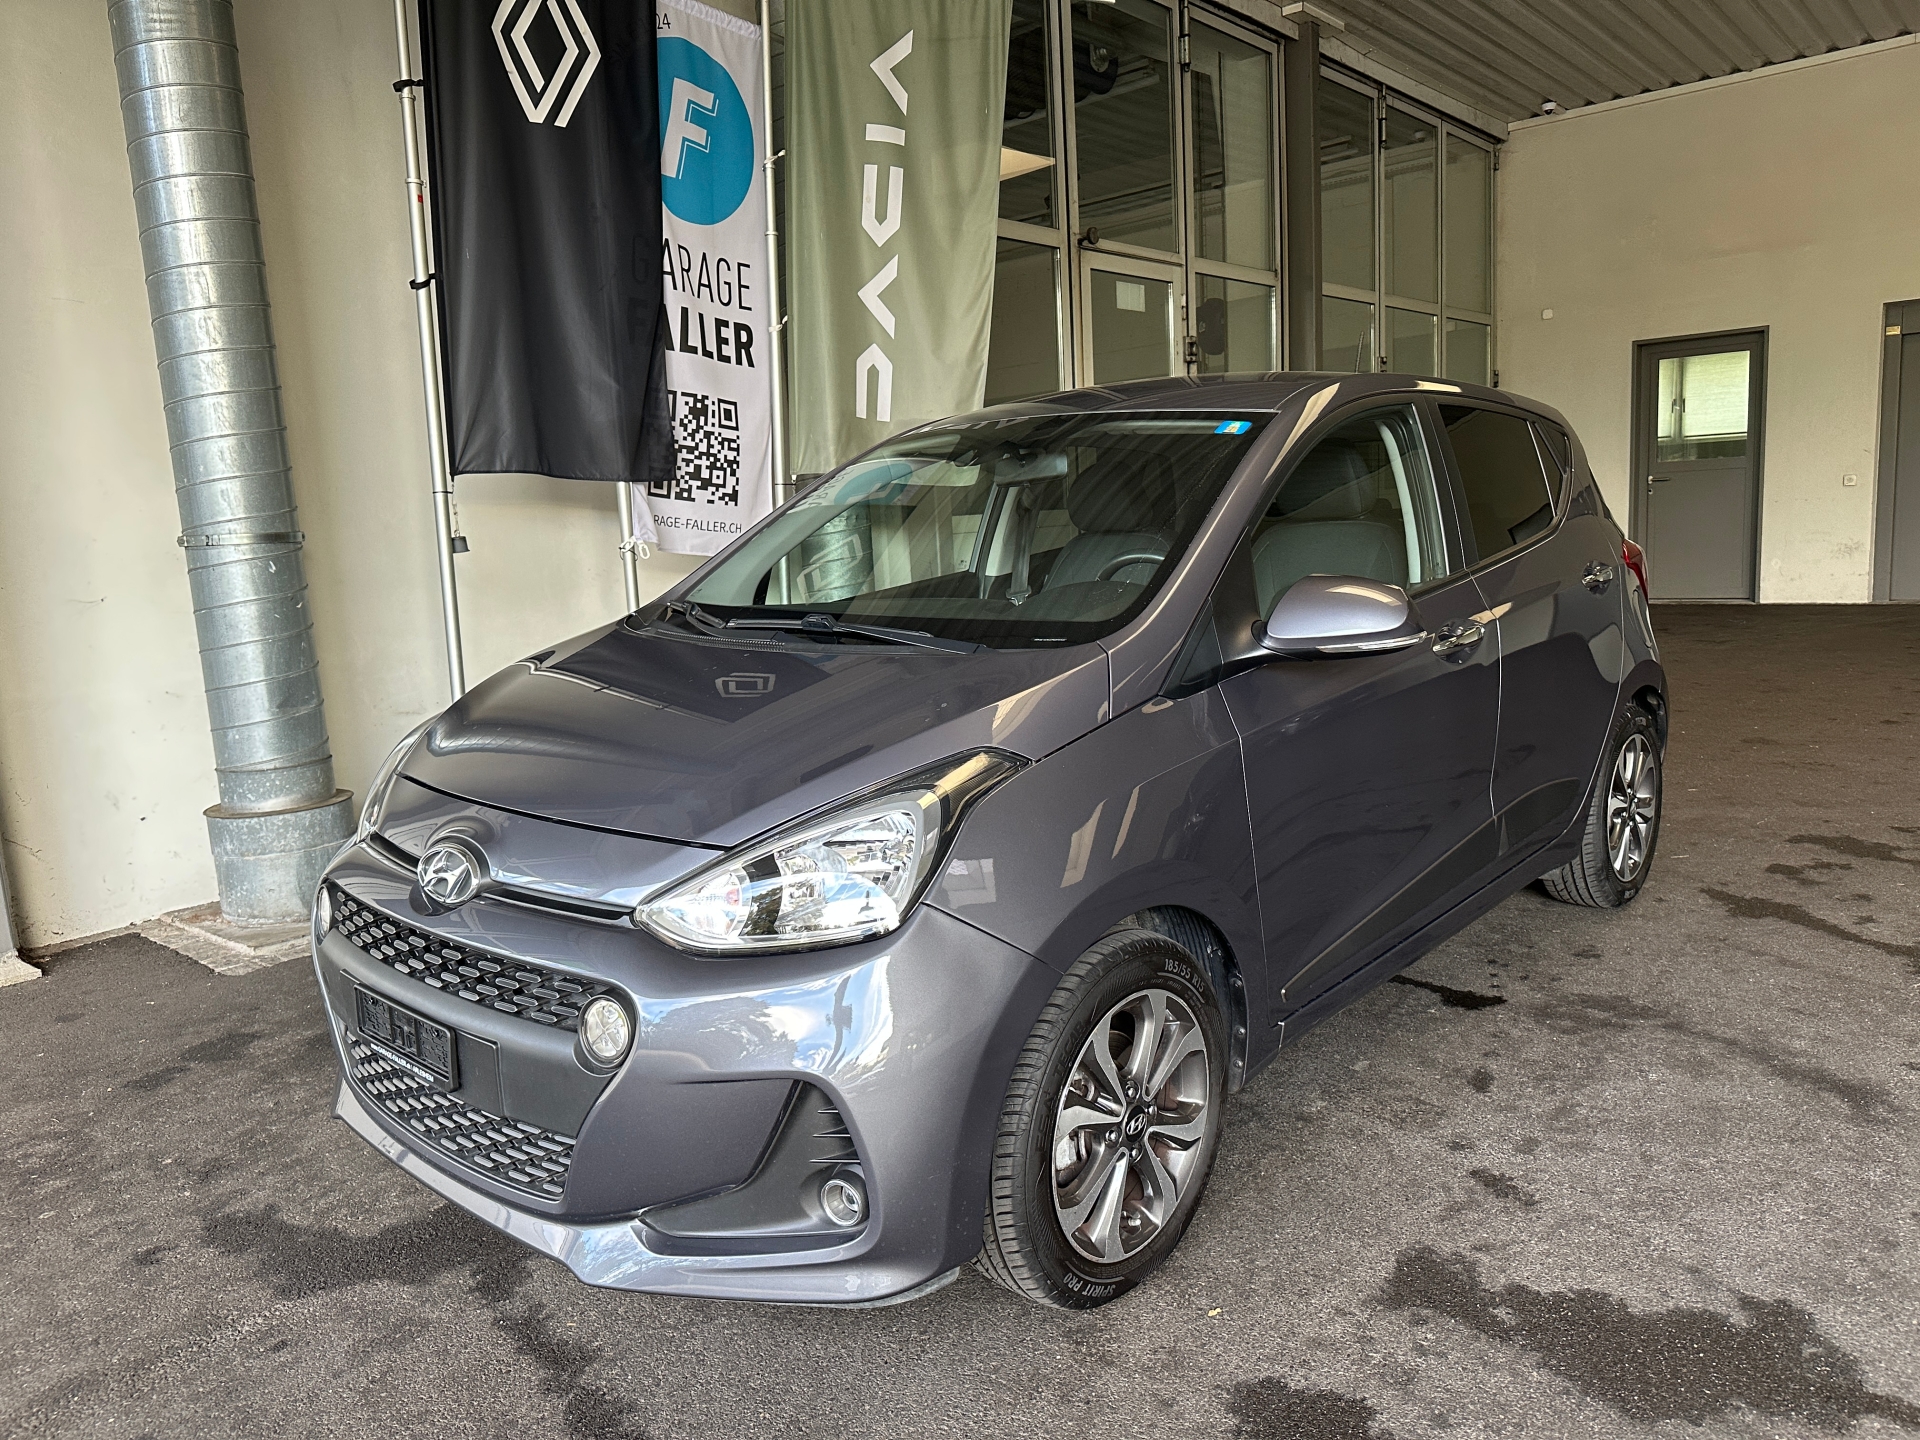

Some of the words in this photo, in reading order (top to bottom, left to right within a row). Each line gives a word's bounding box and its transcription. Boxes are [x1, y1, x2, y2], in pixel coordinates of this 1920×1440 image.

[655, 12, 671, 30] 24
[660, 77, 719, 180] F
[856, 29, 914, 422] DACIA
[653, 514, 742, 534] RAGE-FALLER.CH
[1164, 958, 1191, 979] 185/55
[1192, 975, 1206, 993] R15
[1063, 1272, 1084, 1292] PRO
[1081, 1283, 1117, 1298] SPIRIT
